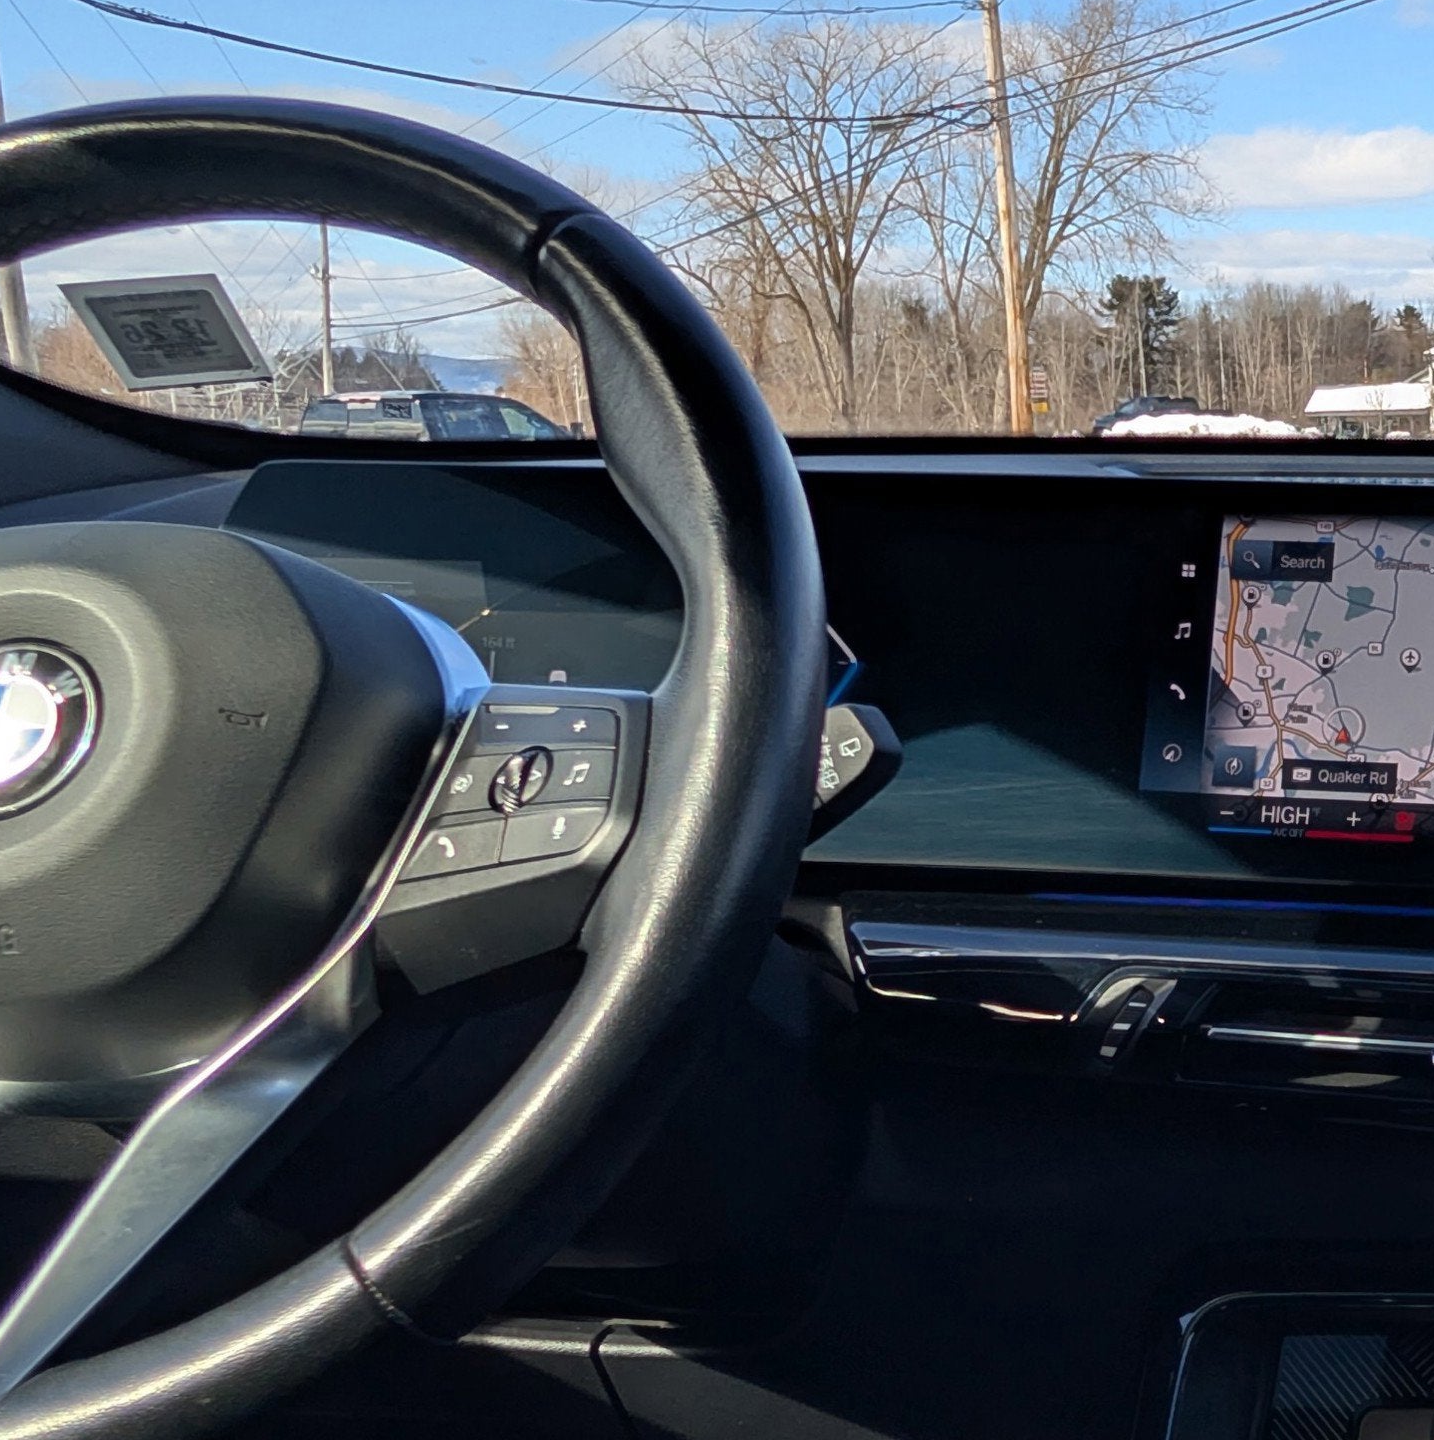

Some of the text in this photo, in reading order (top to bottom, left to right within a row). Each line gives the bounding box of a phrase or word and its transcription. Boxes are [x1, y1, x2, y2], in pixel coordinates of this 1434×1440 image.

[1280, 554, 1326, 570] Search
[1318, 768, 1366, 784] Quaker
[1369, 771, 1389, 785] Rd
[1260, 804, 1311, 825] HIGH
